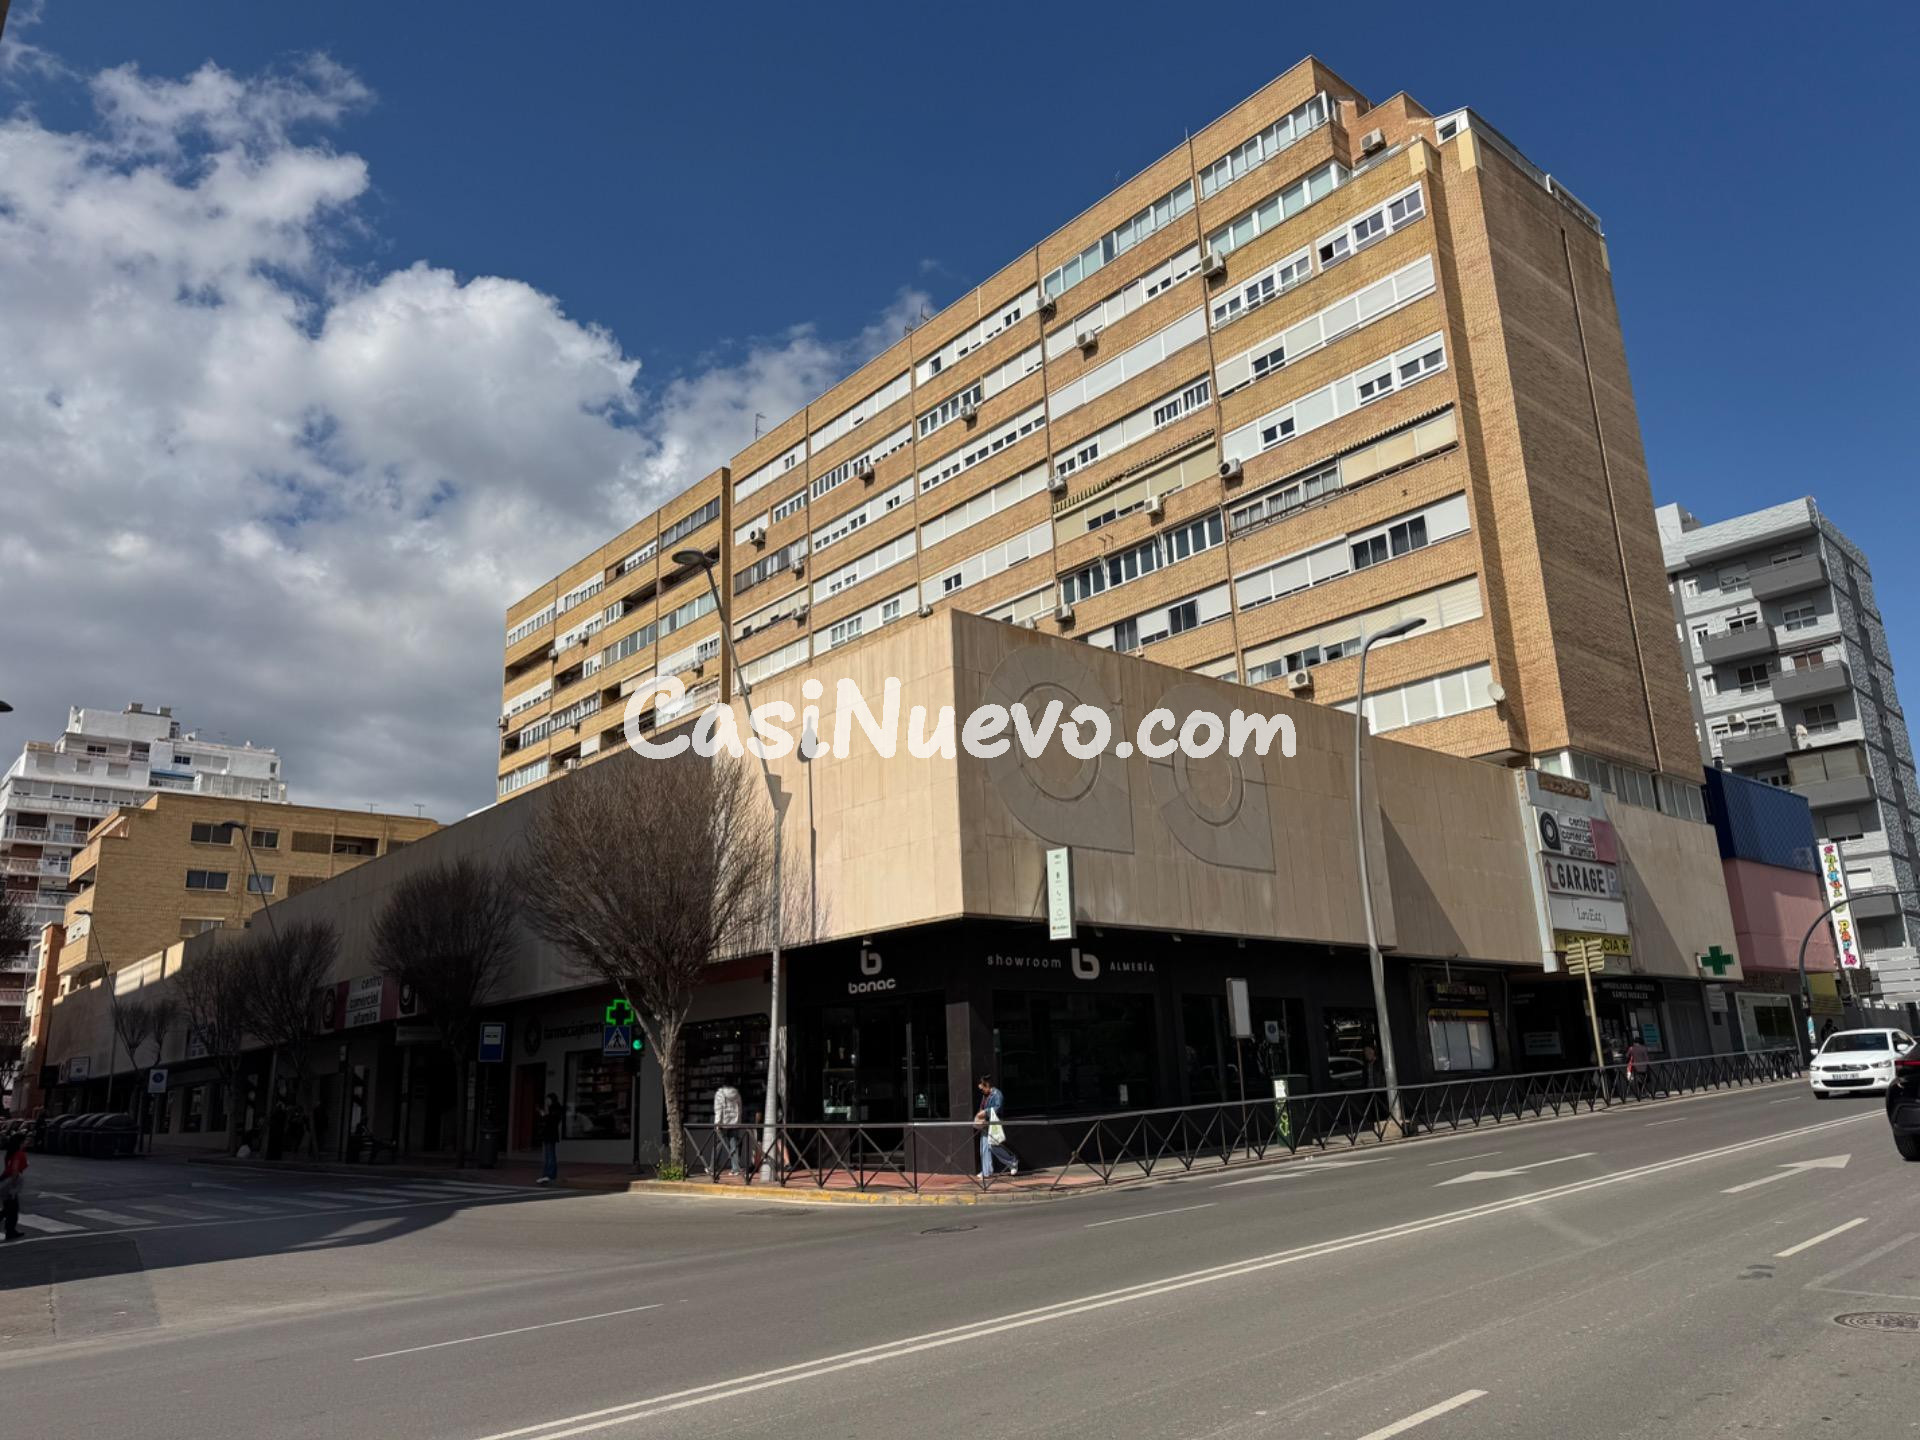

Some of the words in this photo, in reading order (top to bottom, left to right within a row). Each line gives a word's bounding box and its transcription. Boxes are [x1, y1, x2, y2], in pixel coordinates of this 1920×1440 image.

[1557, 863, 1606, 894] GARAGE
[860, 948, 883, 976] b
[986, 953, 1062, 969] showroom
[1070, 947, 1101, 980] b
[848, 978, 896, 995] bonac
